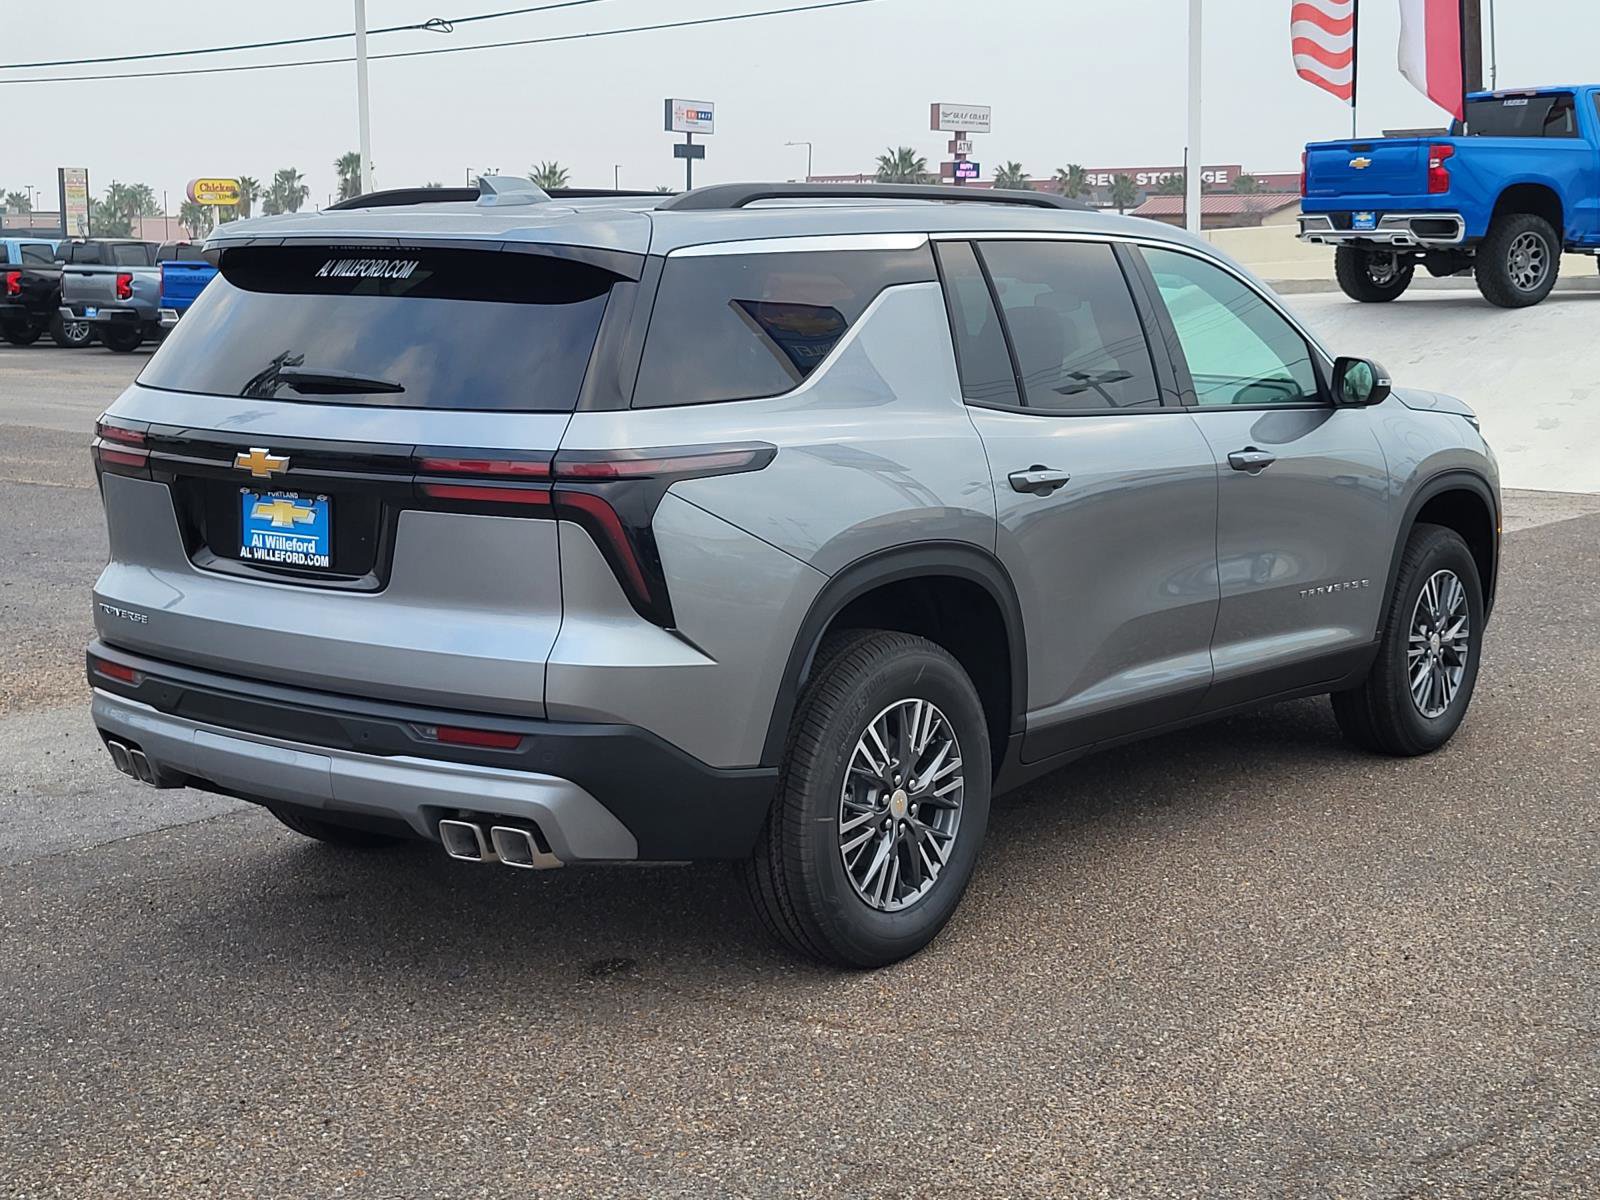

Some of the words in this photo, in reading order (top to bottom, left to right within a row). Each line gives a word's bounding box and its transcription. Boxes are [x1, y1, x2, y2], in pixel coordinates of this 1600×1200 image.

[969, 113, 989, 121] COAST
[958, 142, 972, 152] ATM
[315, 259, 336, 277] AL
[330, 259, 419, 279] WILLEFORD.COM
[252, 533, 263, 547] Al
[265, 535, 316, 553] Willeford
[240, 546, 252, 558] AL
[253, 547, 329, 567] WILLEFORD.COM
[1299, 579, 1369, 599] TRAVERSE
